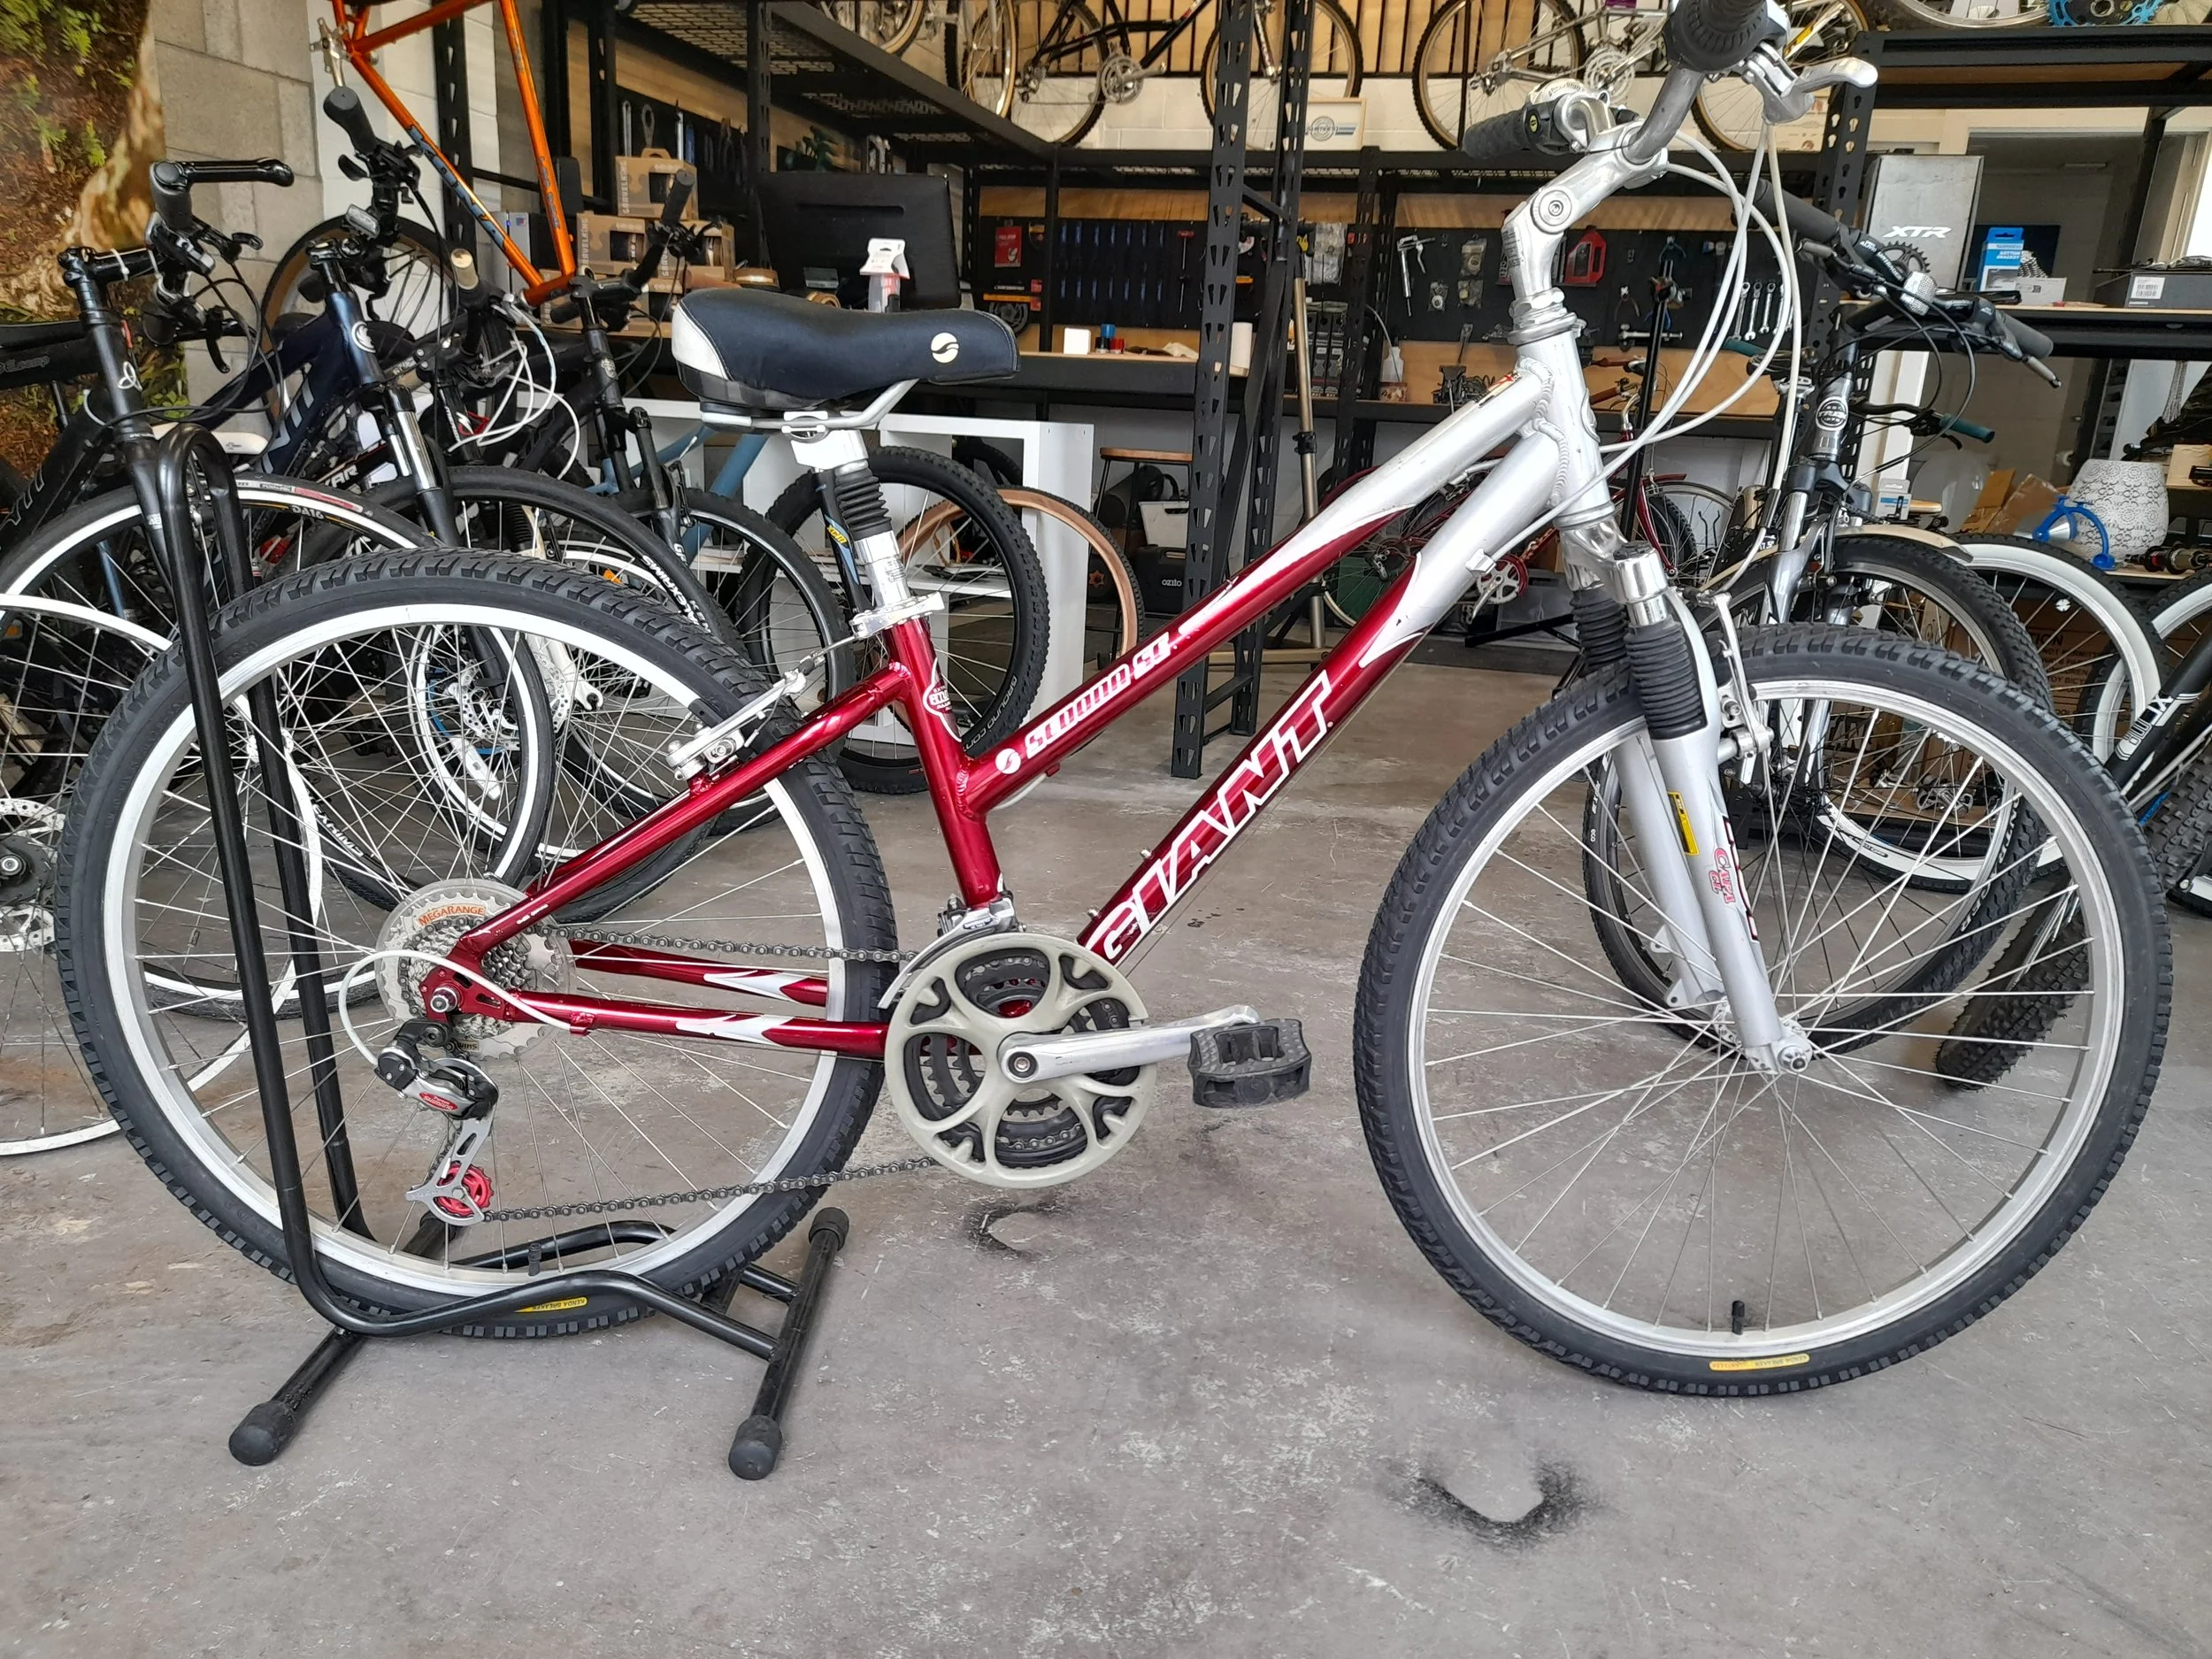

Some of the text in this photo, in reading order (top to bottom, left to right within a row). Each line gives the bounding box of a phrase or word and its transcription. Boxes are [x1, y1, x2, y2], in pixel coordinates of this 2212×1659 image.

[1882, 225, 1953, 239] XTR
[1161, 579, 1183, 588] ozito
[1085, 669, 1333, 960] GIANT
[418, 905, 486, 926] MEGARANGE
[422, 1095, 454, 1110] SHIMANO
[563, 1298, 586, 1308] KENDA
